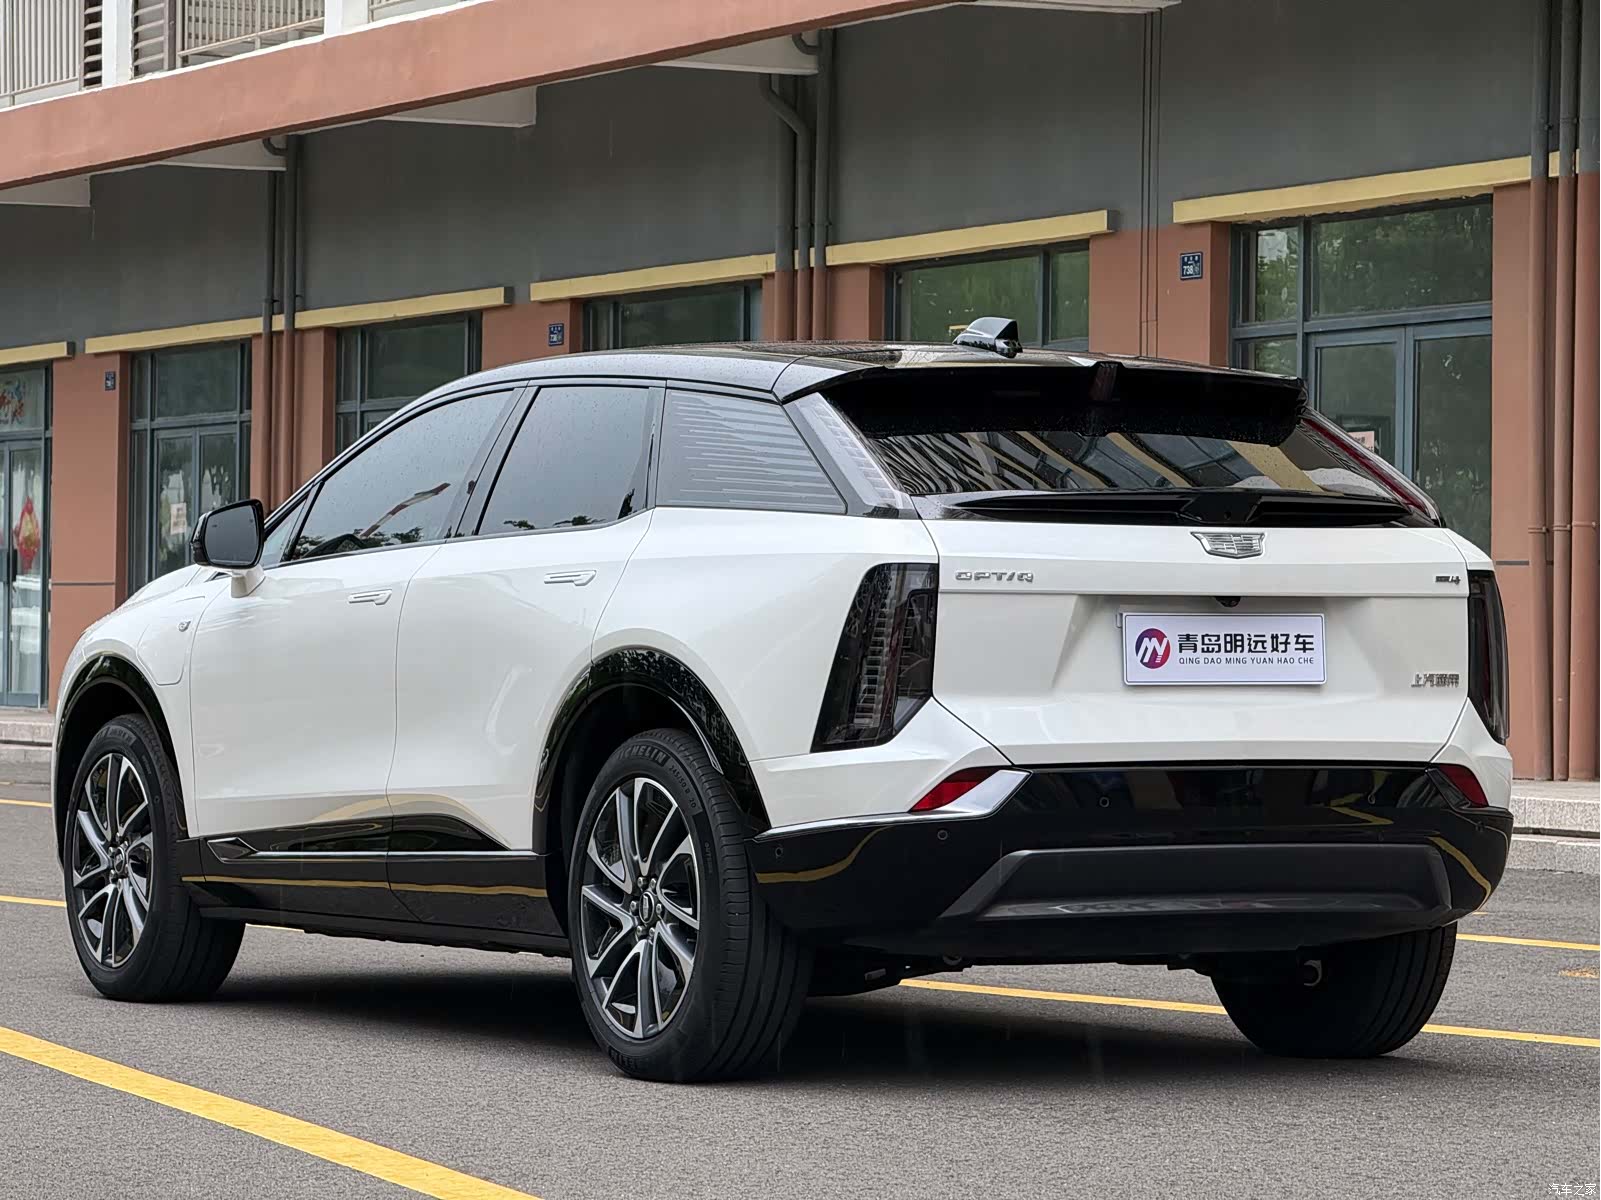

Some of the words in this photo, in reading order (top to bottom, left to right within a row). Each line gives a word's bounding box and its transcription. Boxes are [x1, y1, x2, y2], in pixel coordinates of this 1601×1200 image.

[955, 571, 1033, 583] OPTIQ
[1177, 633, 1315, 654] 青岛明远好车
[1179, 657, 1200, 665] QING
[1203, 657, 1222, 665] DAO
[1225, 657, 1247, 665] MING
[1250, 657, 1274, 665] YUAN
[1277, 657, 1295, 665] HAO
[1298, 657, 1314, 665] CHE
